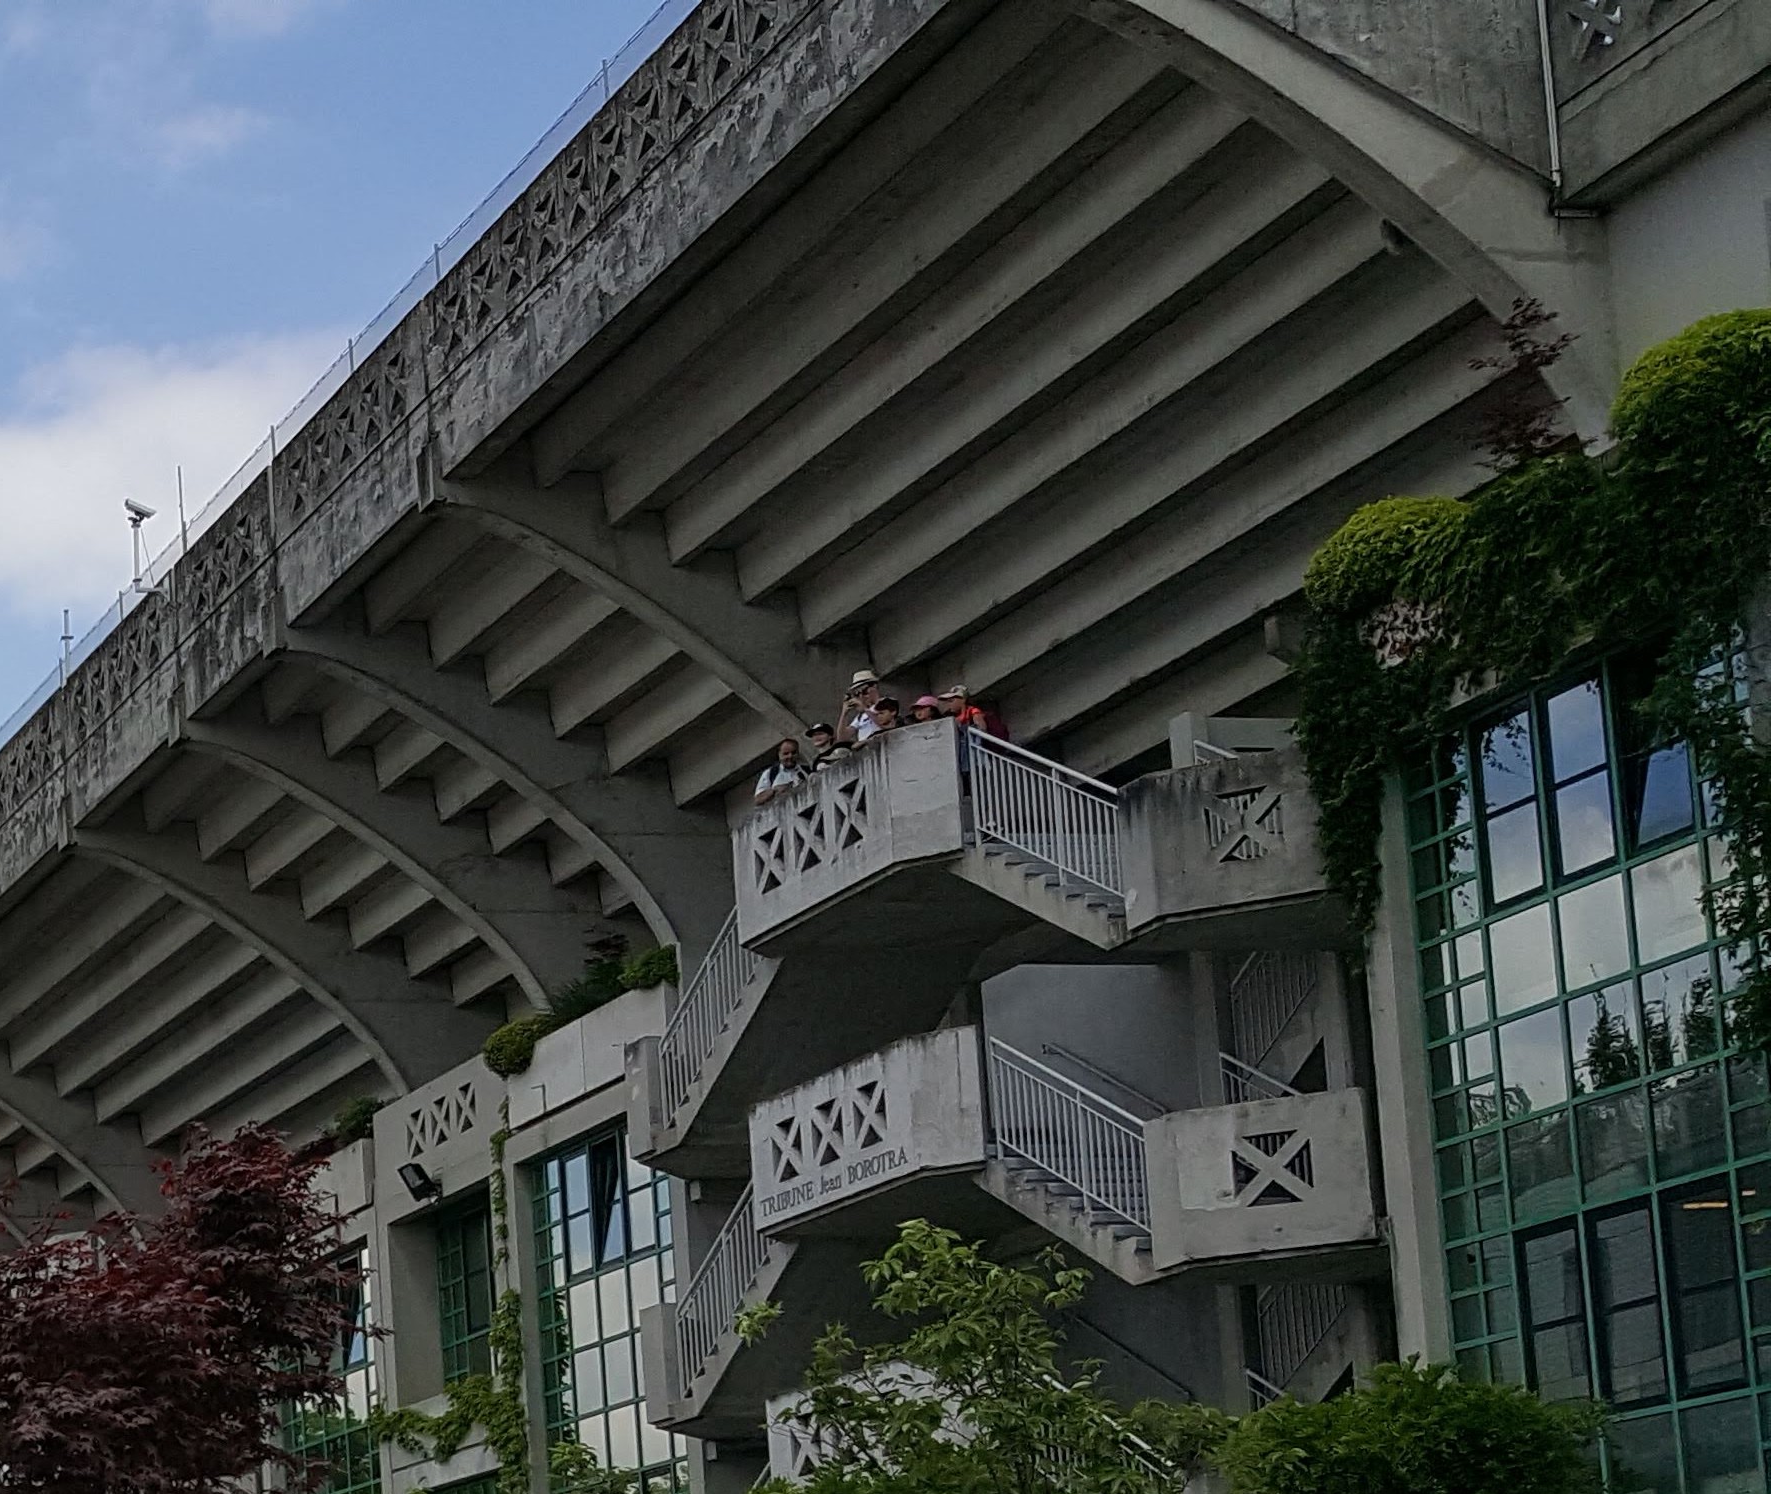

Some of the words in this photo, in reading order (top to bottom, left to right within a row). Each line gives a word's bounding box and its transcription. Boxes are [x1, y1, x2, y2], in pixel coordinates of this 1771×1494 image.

[760, 1181, 814, 1216] TRIBUNE
[820, 1175, 842, 1196] Jean
[848, 1146, 908, 1185] BOROTRA
